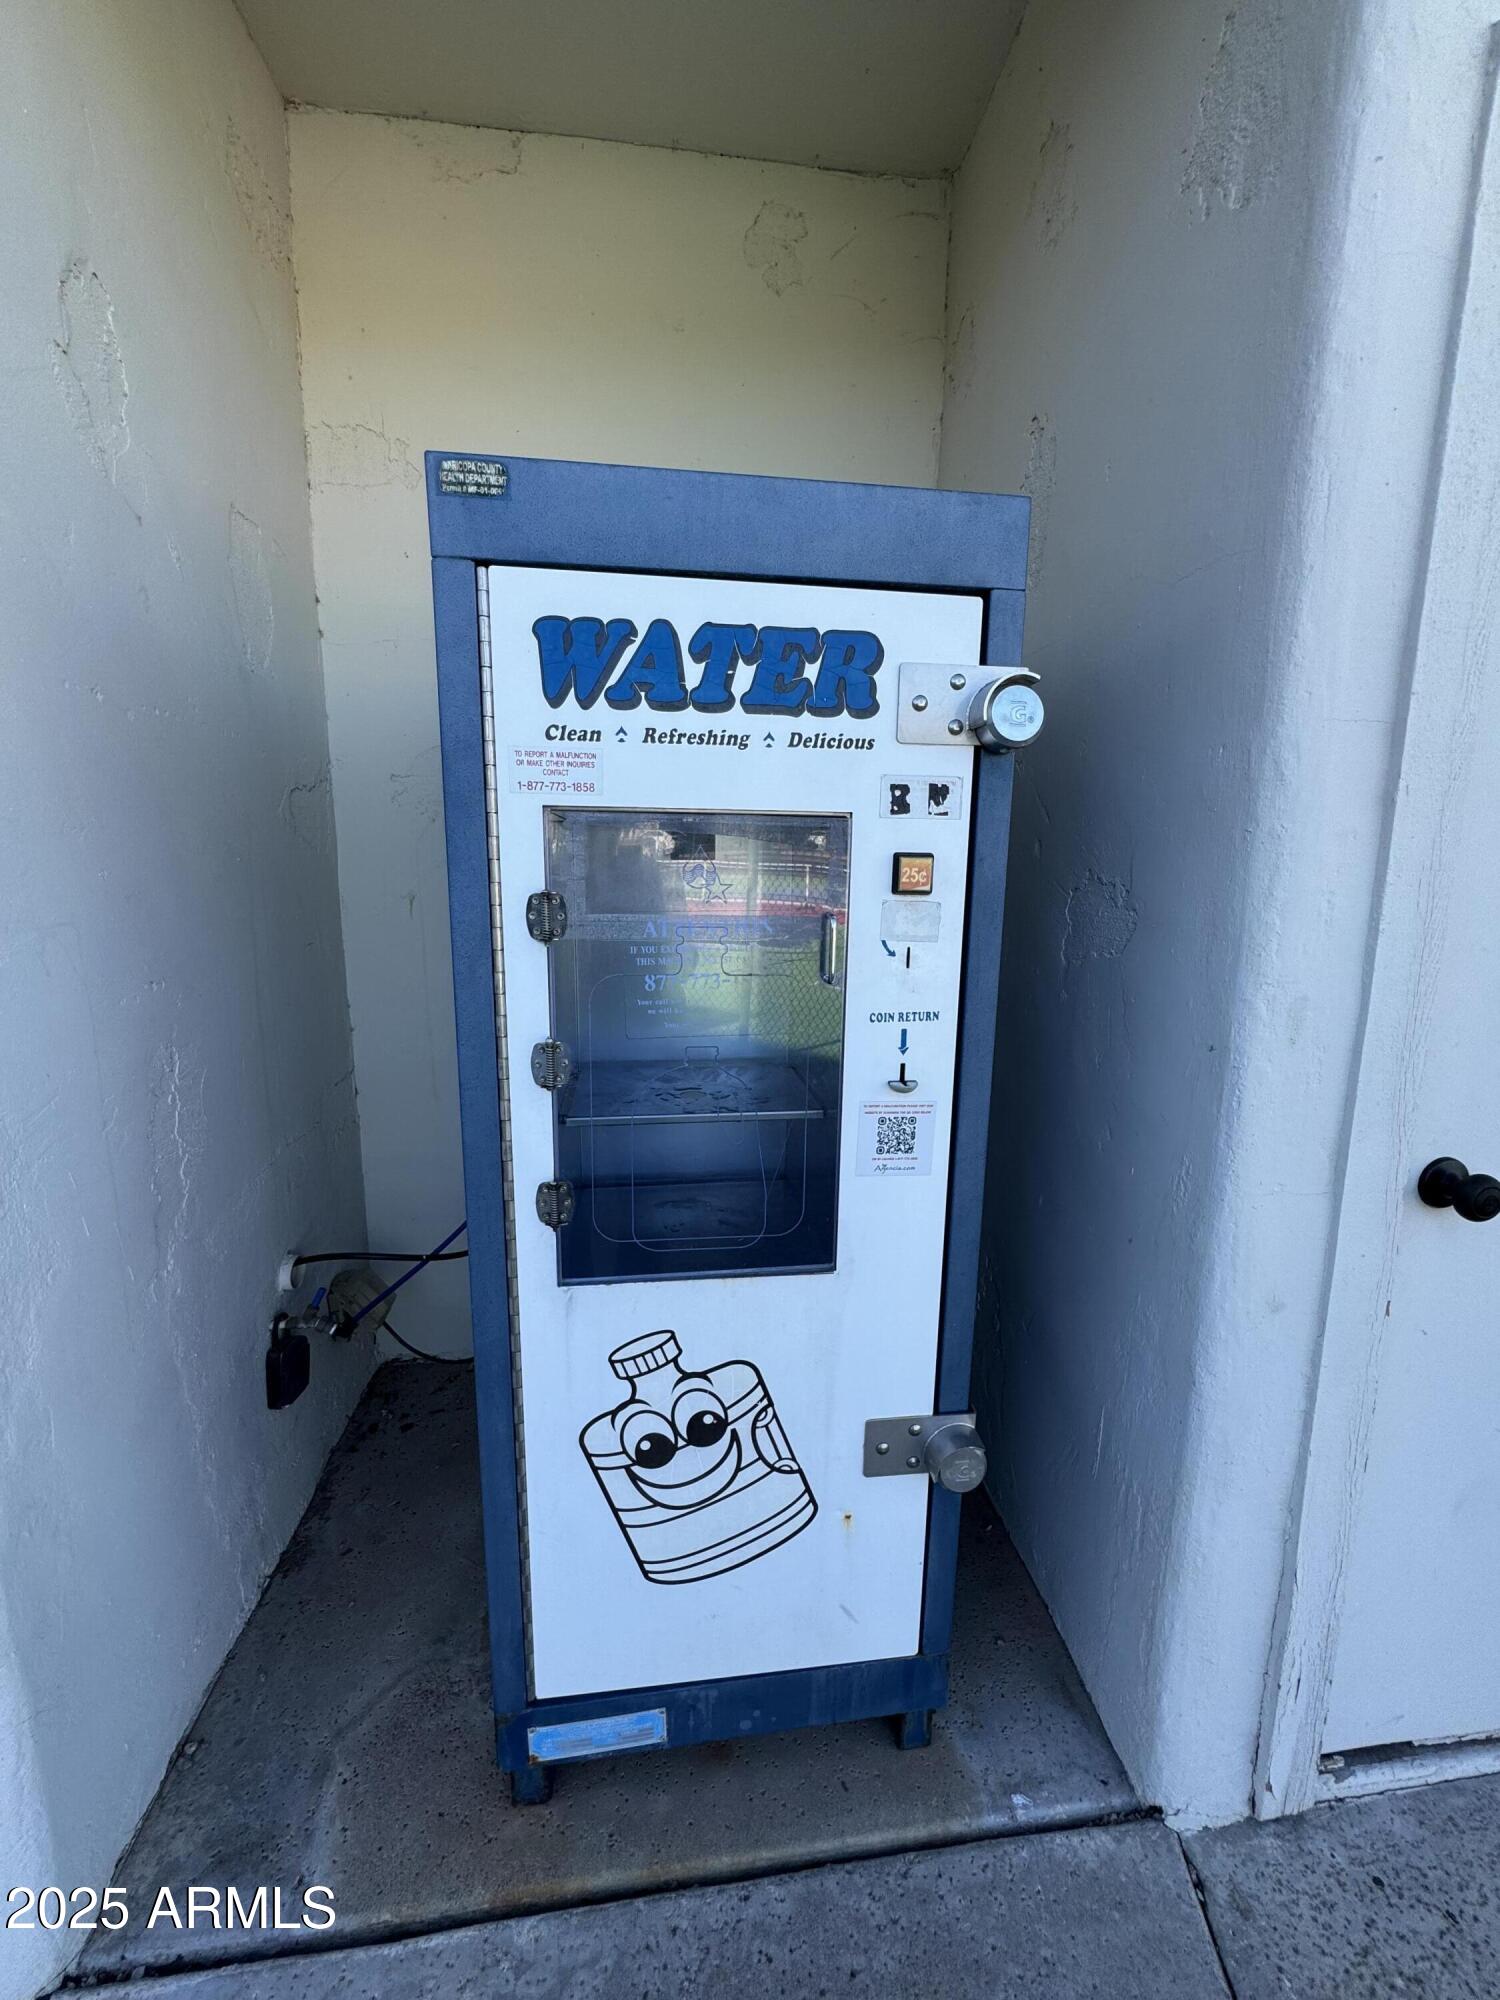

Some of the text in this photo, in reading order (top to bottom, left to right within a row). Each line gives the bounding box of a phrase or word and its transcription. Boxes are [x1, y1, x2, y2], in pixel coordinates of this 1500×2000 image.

[477, 463, 503, 474] COUNTY
[532, 615, 885, 719] WATER
[544, 723, 876, 751] Clean Refreshing Delicious
[524, 750, 548, 758] REPORT
[556, 751, 597, 759] MALFUNCTION
[526, 759, 544, 767] MAKE
[545, 760, 565, 768] OTHER
[566, 761, 596, 769] INQUIRIES
[542, 768, 569, 777] CONTACT
[517, 780, 596, 793] 1-877-773-1858
[901, 867, 928, 886] 25¢
[640, 945, 658, 955] YOU
[636, 957, 656, 967] THIS
[869, 1010, 940, 1023] COIN RETURN
